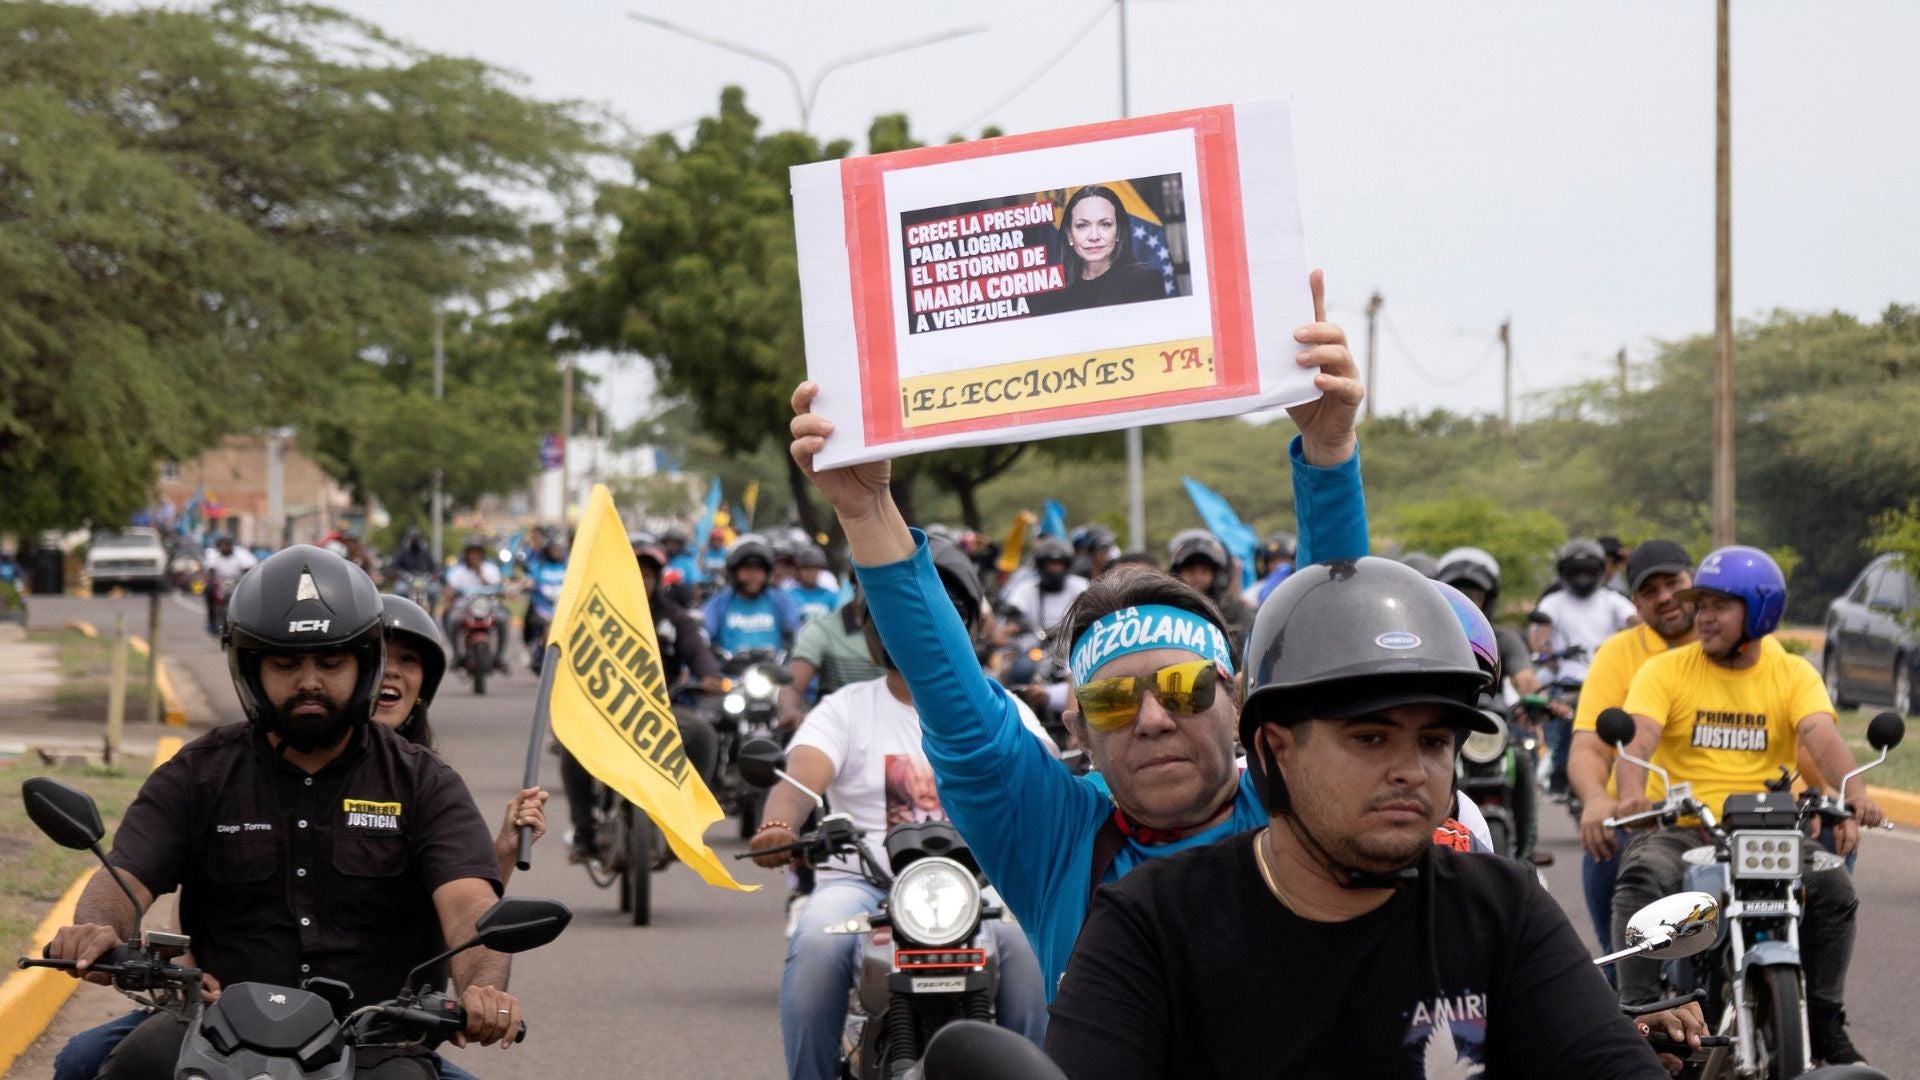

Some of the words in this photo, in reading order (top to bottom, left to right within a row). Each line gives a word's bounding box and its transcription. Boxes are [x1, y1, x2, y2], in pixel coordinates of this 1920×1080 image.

[908, 220, 958, 245] CRECE
[960, 217, 981, 236] LA
[983, 202, 1053, 232] PRESIÓN
[910, 242, 956, 265] PARA
[958, 230, 1024, 258] LOGRAR
[911, 266, 933, 286] EL
[935, 252, 1019, 282] RETORNO
[1022, 246, 1045, 268] DE
[913, 281, 984, 312] MARÍA
[986, 266, 1063, 300] CORINA
[916, 314, 930, 333] A
[932, 297, 1030, 329] VENEZUELA
[1093, 620, 1104, 633] A
[1115, 606, 1139, 620] LA
[1695, 710, 1767, 727] PRIMERO
[1692, 725, 1767, 751] JUSTICIA
[347, 813, 397, 829] JUSTICIA
[349, 802, 397, 815] PRIMERO
[217, 824, 240, 834] Diego
[243, 823, 272, 831] Torres
